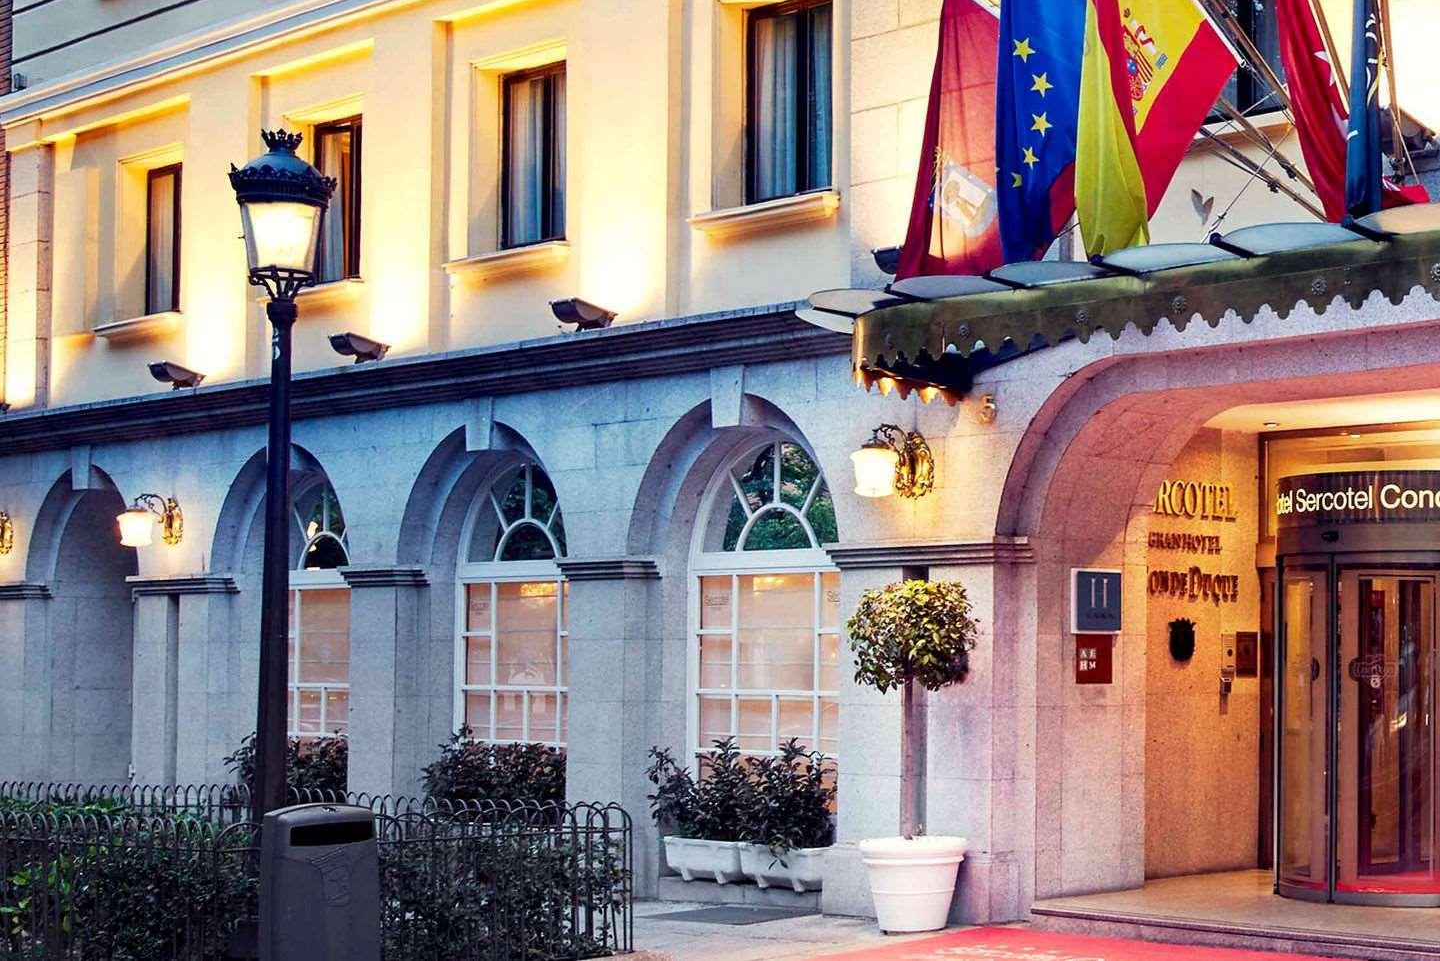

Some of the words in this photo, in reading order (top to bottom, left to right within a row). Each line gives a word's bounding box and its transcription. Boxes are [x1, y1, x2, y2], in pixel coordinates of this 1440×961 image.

[1152, 479, 1236, 521] RCOTEL
[1296, 485, 1373, 512] Sercotel
[1182, 533, 1222, 555] HOTEL
[1146, 566, 1188, 599] ONDE
[1188, 566, 1239, 607] DUQUE
